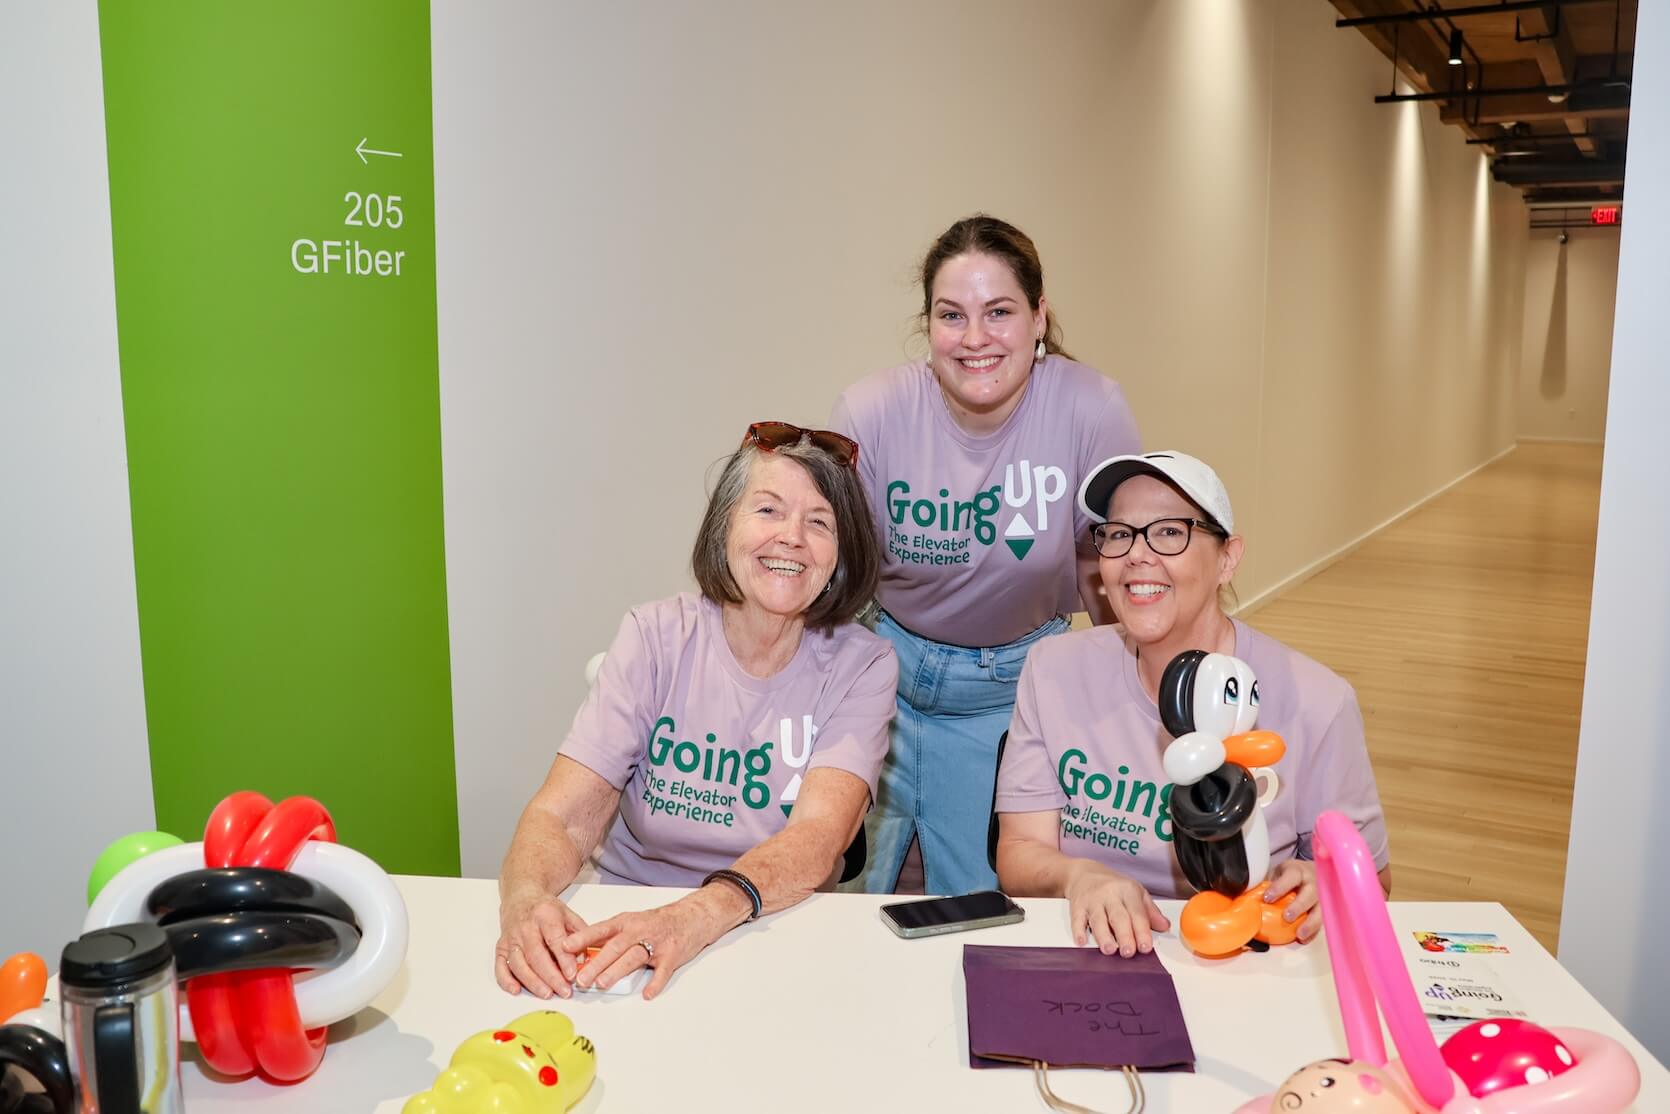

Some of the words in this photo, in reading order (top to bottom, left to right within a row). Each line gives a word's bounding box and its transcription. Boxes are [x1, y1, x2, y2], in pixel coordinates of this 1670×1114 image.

[344, 191, 403, 229] 205
[1597, 208, 1617, 224] EXIT
[291, 239, 405, 276] GFiber
[887, 480, 1002, 545] Going
[1004, 460, 1067, 531] Up
[889, 526, 908, 545] The
[913, 534, 970, 551] Elevator
[889, 541, 970, 565] Experience
[648, 716, 774, 810] Going
[780, 715, 819, 768] U
[643, 789, 734, 828] Experience
[671, 780, 737, 808] Elevator
[1060, 818, 1140, 856] xperience
[1042, 1000, 1142, 1017] Dock
[1088, 1020, 1160, 1036] The
